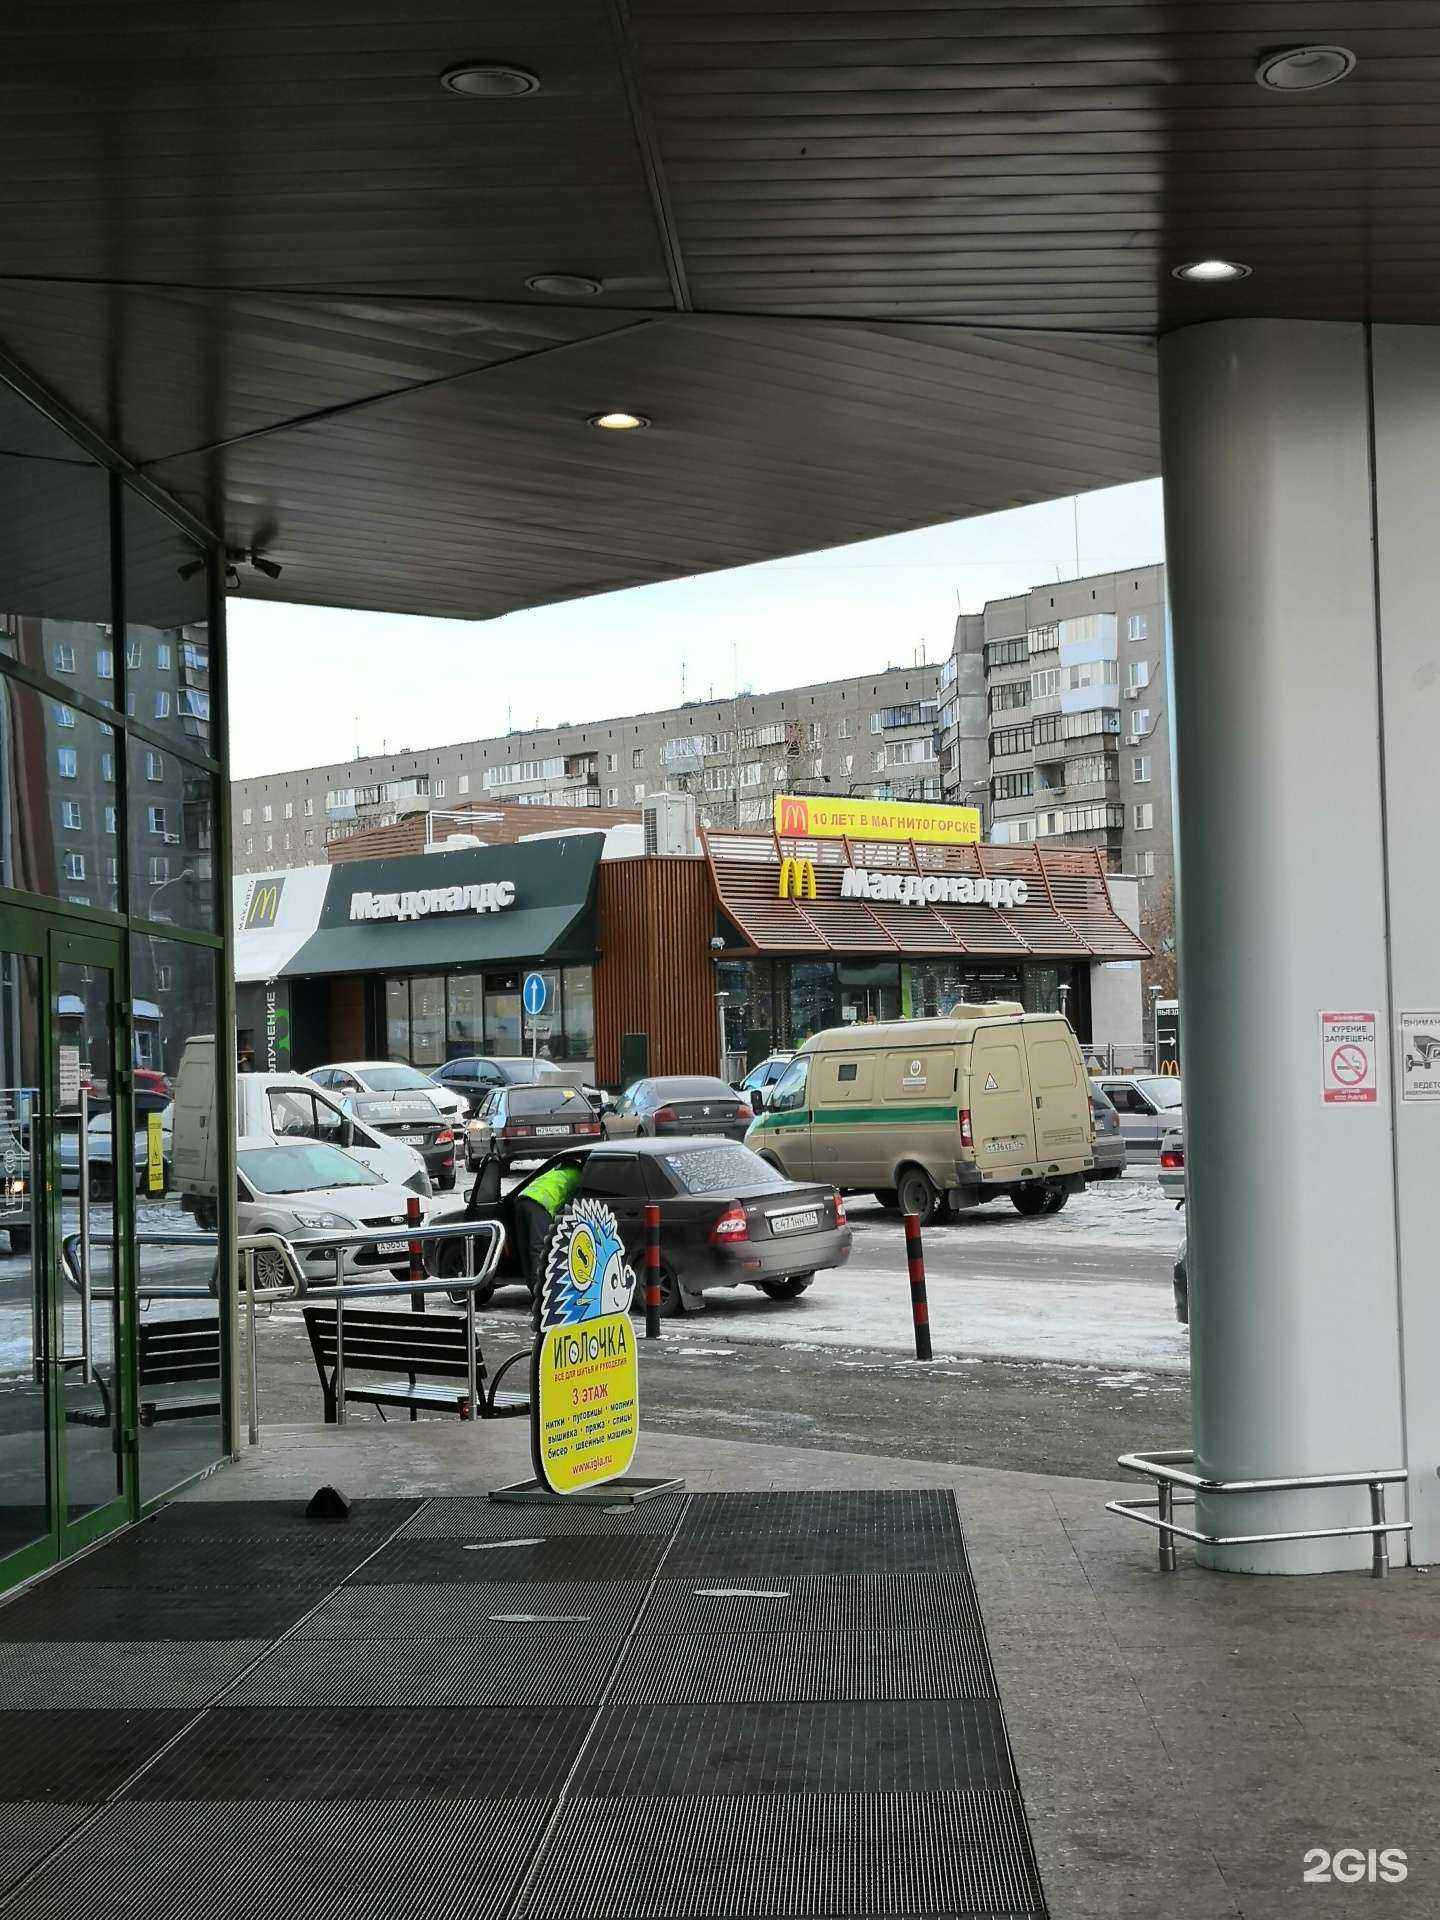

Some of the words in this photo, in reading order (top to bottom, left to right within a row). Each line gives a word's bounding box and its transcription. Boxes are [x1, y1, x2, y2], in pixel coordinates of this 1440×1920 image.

[813, 813, 827, 825] 10
[831, 814, 854, 826] ЛЕТ
[860, 815, 868, 826] В
[872, 816, 977, 834] МАГНИТОГОРСКЕ
[349, 881, 515, 921] Макдоналдс
[840, 868, 1029, 909] Макдоналдс
[1325, 1035, 1374, 1043] ЗАПРЕЩЕНО
[576, 1365, 595, 1376] ШИТЬЯ
[599, 1358, 628, 1371] РУКОДЕЛИЯ
[572, 1387, 579, 1406] 3
[582, 1383, 609, 1403] ЭТАЖ
[545, 1417, 565, 1430] нитки
[572, 1407, 603, 1425] пуговицы
[610, 1398, 634, 1411] молнии
[547, 1429, 578, 1444] вышивка
[585, 1421, 605, 1435] пряжа
[612, 1413, 633, 1426] спицы
[547, 1446, 568, 1459] бисер
[575, 1436, 605, 1451] швейные
[607, 1427, 633, 1440] машины
